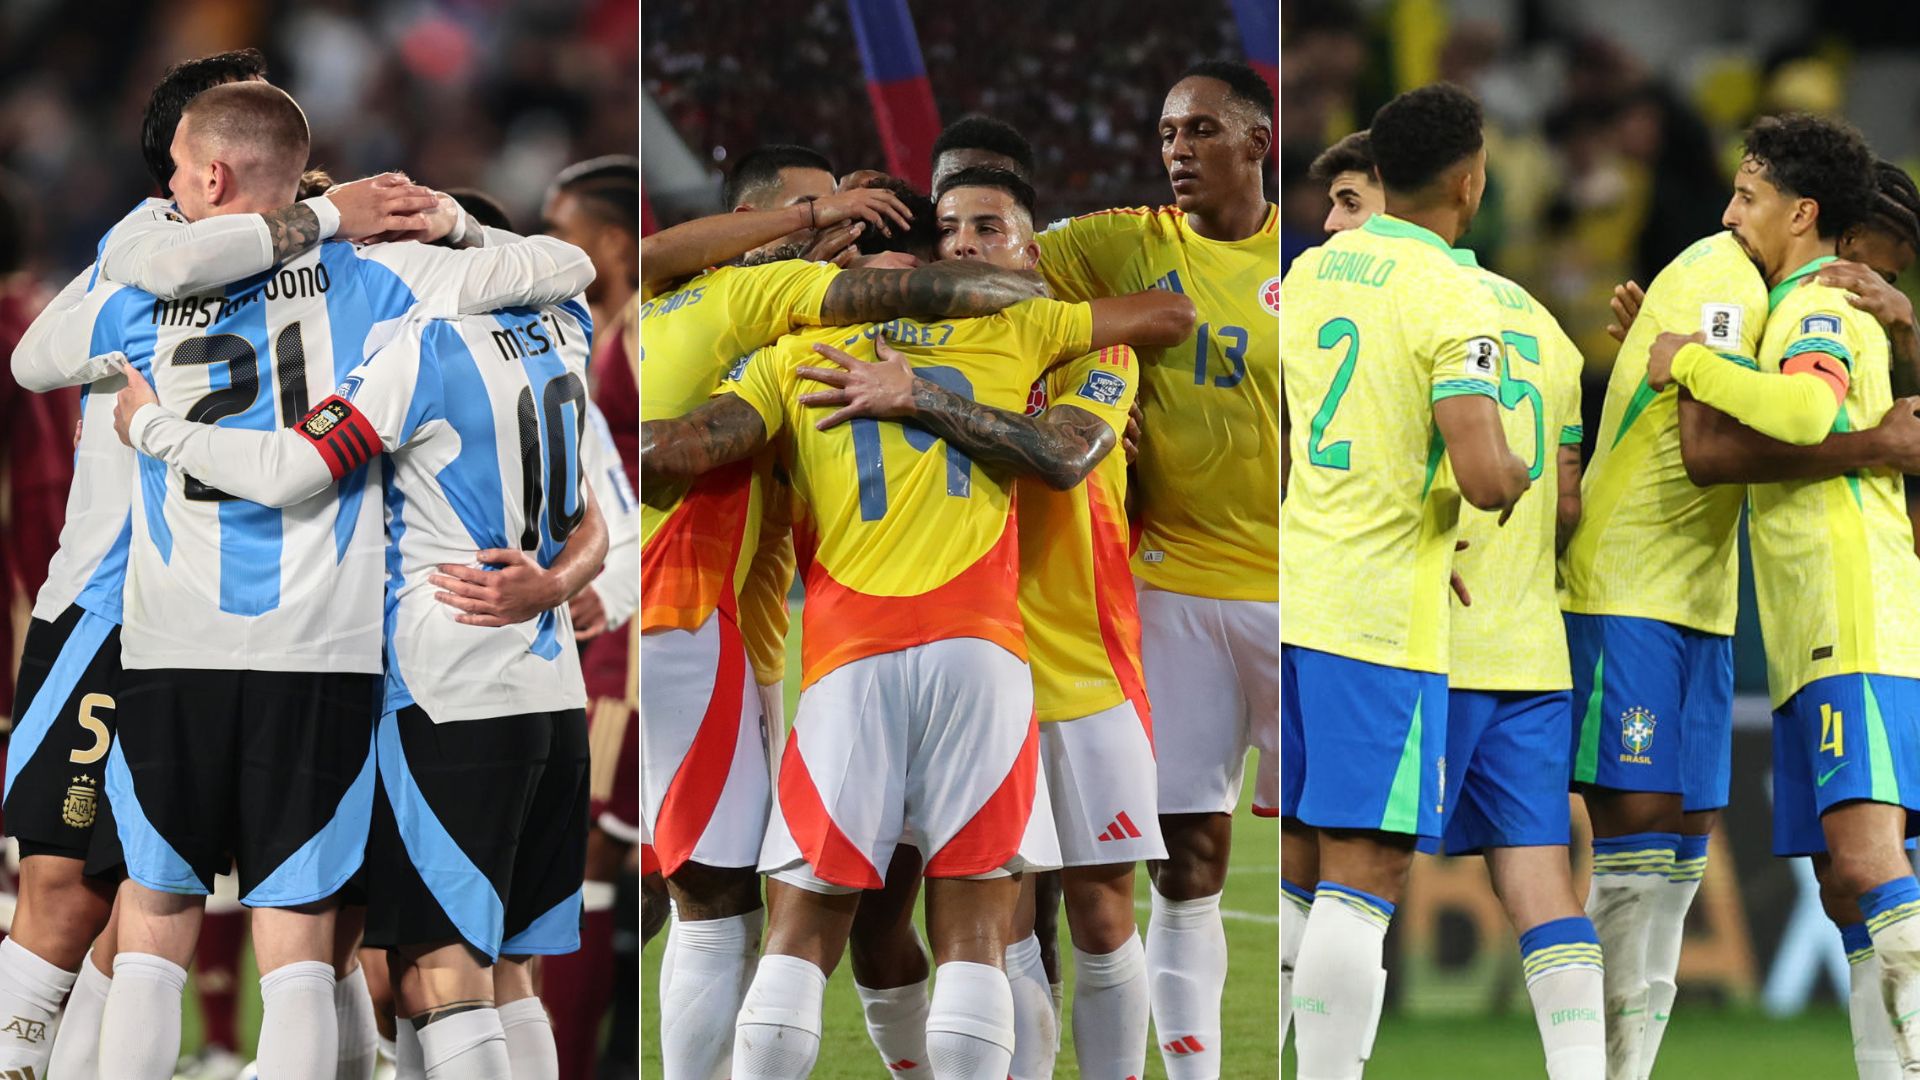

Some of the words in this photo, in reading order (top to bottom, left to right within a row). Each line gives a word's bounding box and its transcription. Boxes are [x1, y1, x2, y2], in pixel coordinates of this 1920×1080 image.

[1317, 250, 1396, 288] DANILO
[1194, 322, 1248, 388] 13
[1308, 317, 1359, 470] 2
[518, 371, 586, 552] 10
[69, 692, 116, 764] 5
[1820, 703, 1843, 757] 4
[1619, 754, 1652, 765] BRASIL
[1, 1015, 46, 1043] AFA
